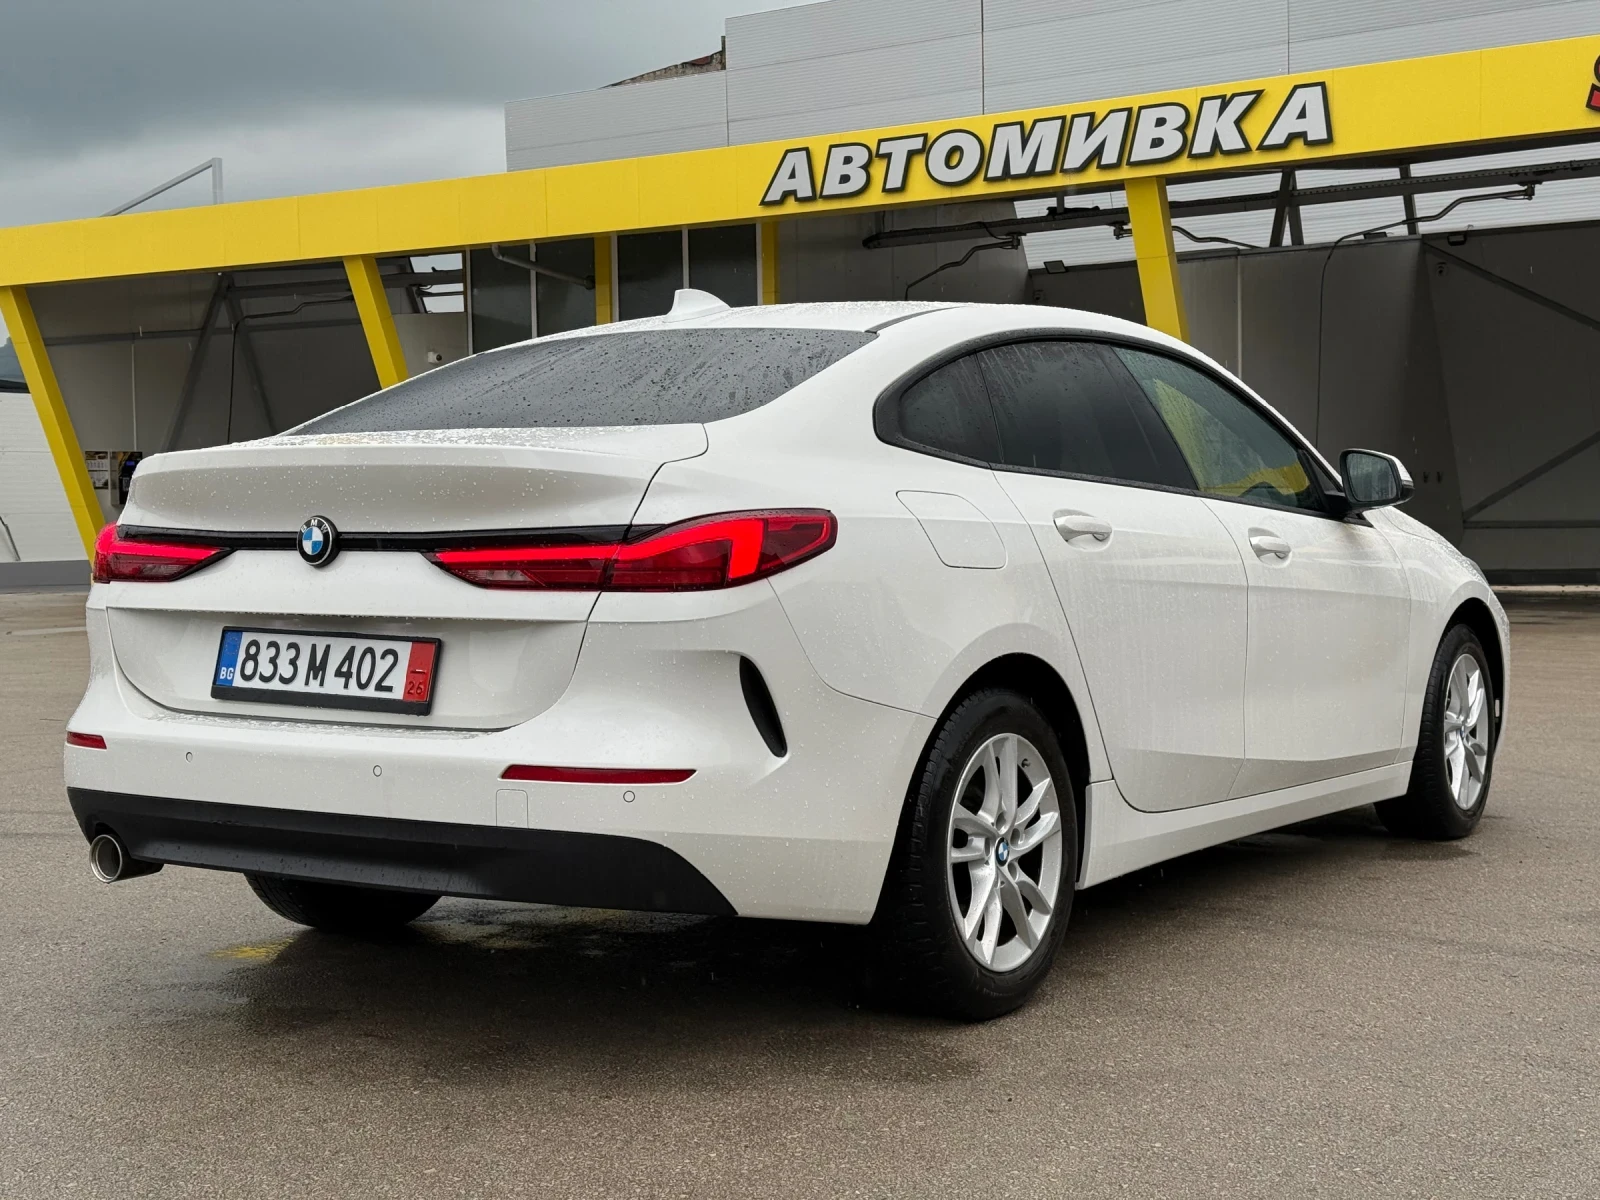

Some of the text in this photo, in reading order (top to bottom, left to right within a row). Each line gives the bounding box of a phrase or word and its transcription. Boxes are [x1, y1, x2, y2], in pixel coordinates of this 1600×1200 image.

[759, 82, 1333, 205] АВТОМИВКА
[300, 519, 329, 534] BMW
[220, 666, 234, 680] BG
[239, 639, 399, 692] 833 M 402
[407, 681, 423, 695] 26
